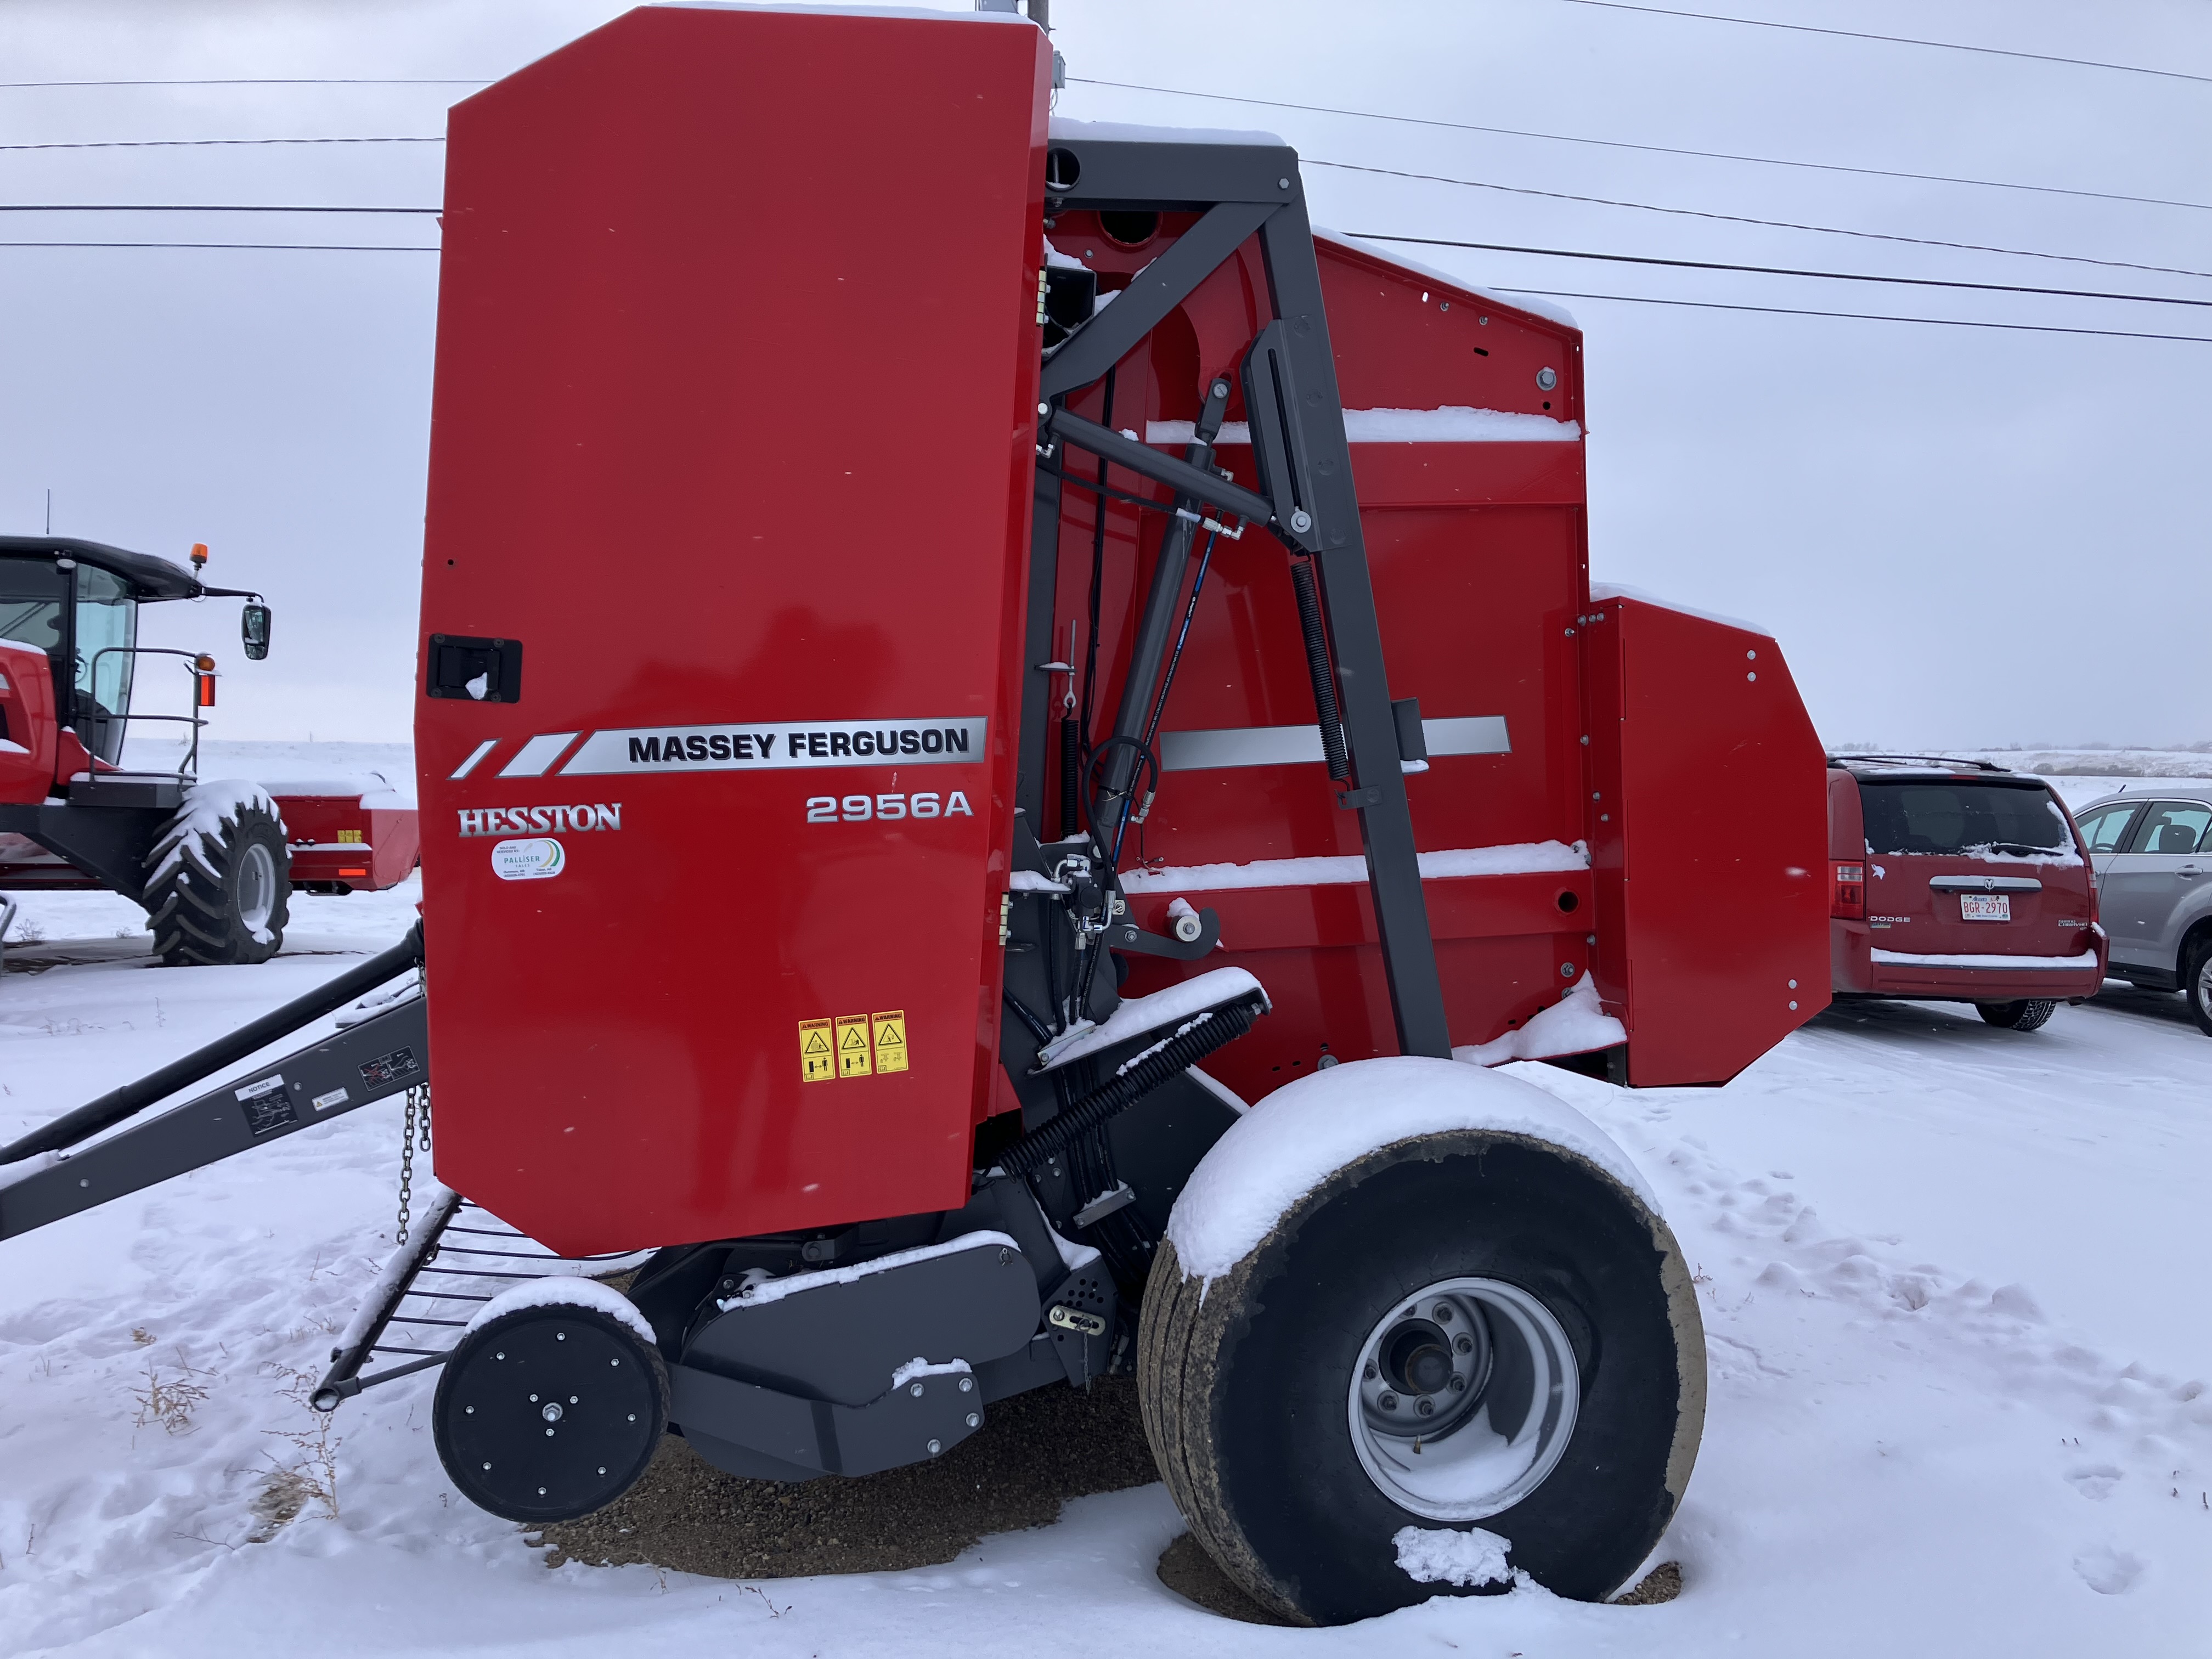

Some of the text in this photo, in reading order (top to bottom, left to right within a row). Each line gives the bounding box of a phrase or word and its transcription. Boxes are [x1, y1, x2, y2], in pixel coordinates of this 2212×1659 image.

[628, 728, 969, 763] MASSEY FERGUSON
[806, 791, 974, 823] 2956A
[457, 802, 622, 837] HESSTON
[504, 855, 540, 864] PALLISER
[1963, 902, 2008, 914] BGR-2970
[248, 1081, 270, 1093] NOTICE
